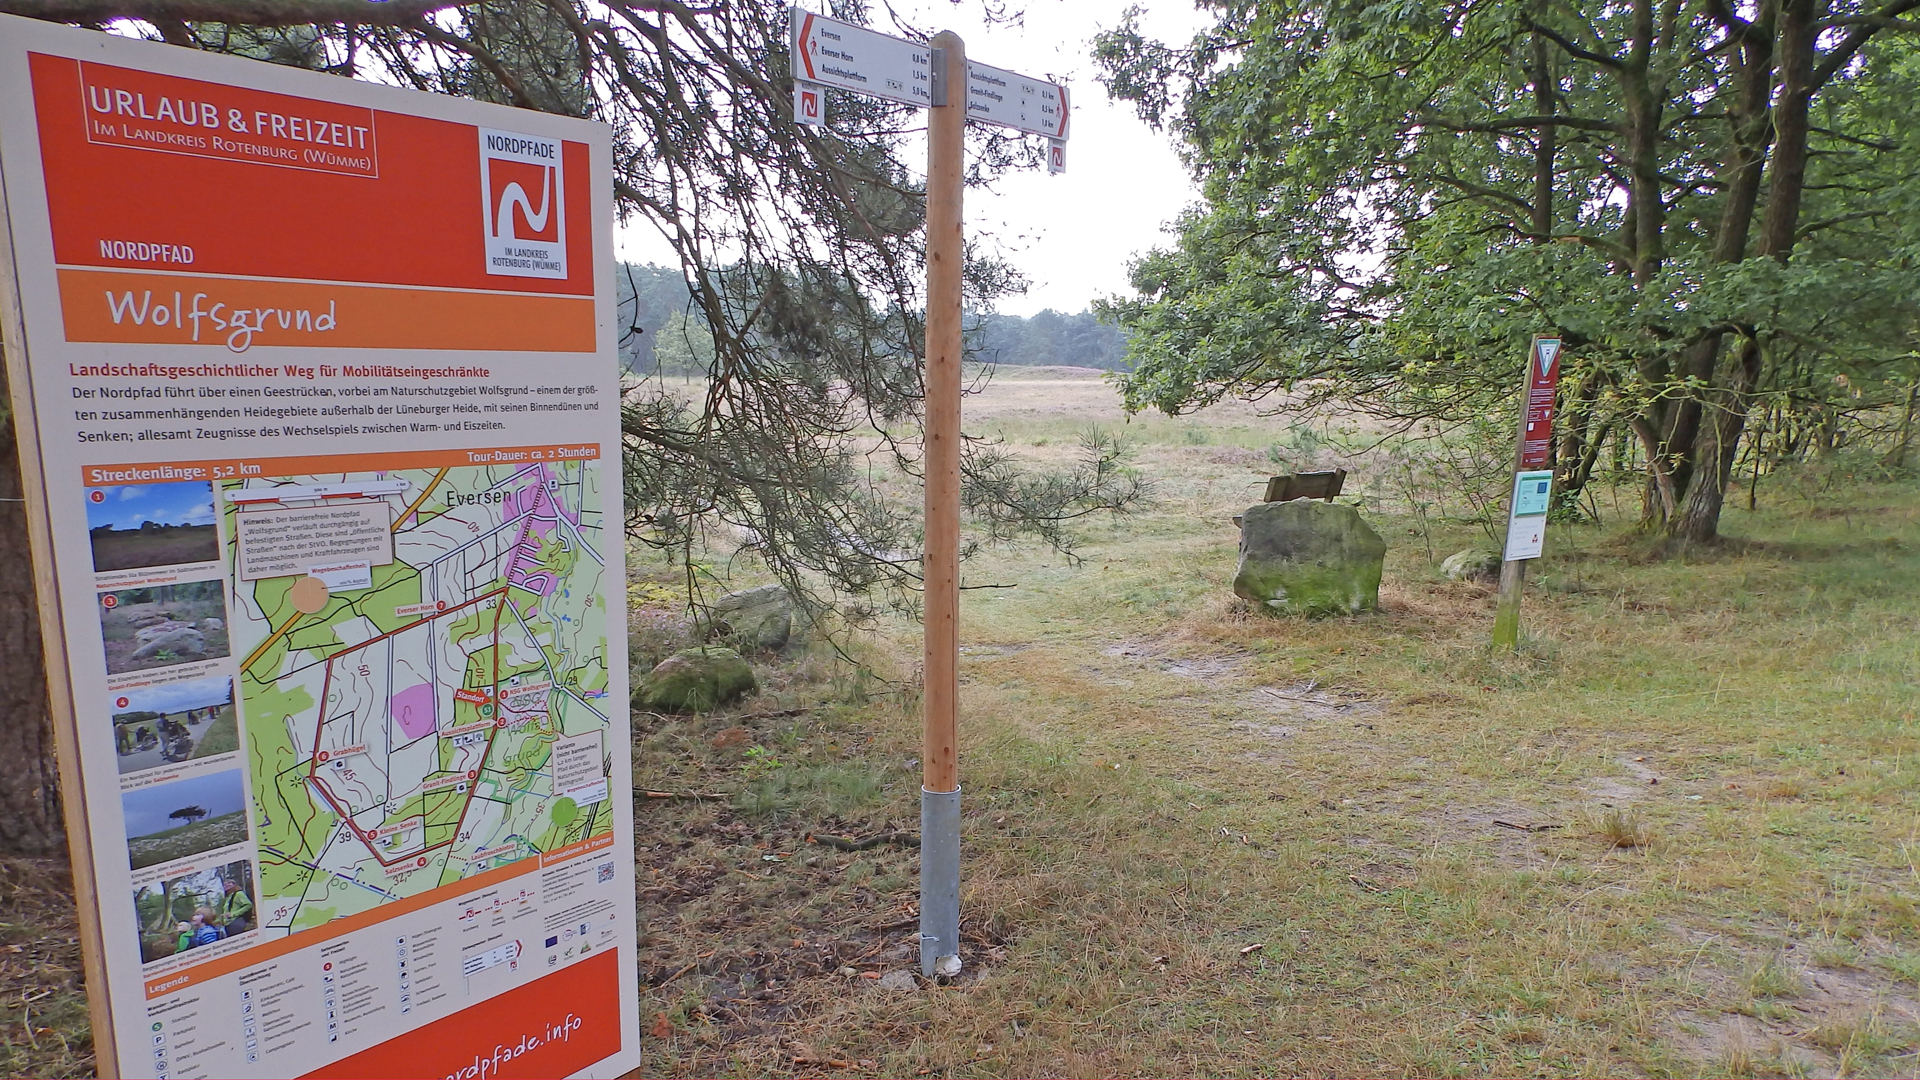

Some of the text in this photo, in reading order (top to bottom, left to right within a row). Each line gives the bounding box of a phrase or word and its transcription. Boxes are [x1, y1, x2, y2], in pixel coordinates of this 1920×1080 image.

[821, 28, 841, 41] Eversen
[821, 46, 853, 62] Everser Horn
[920, 55, 927, 65] km
[822, 64, 867, 83] Aussichtsplattform
[920, 72, 927, 81] km
[971, 71, 1006, 87] Aussichtsplattform
[920, 88, 927, 97] km
[970, 86, 1003, 102] Granit-Findlinge
[90, 85, 369, 150] URLAUB & FREIZEIT
[487, 135, 555, 159] NORDPFADE
[99, 238, 194, 264] NORDPFAD
[505, 247, 548, 260] IM LANDKREIS
[493, 257, 561, 272] ROTENBURG (WÜMME)
[105, 290, 337, 353] Wolfsgrund
[69, 362, 490, 380] Landschaftsgeschichtlicher Weg für Mobilitätseingeschränkte
[72, 385, 598, 400] Der Nordpfad führt über einen Geestrücken, vorbei am Naturschutzgebiet Wolfsgrund einem der größ-
[75, 402, 598, 421] ten zusammenhängenden Heidegebiete außerhalb der Lüneburger Heide, mit seinen Binnendünen und
[78, 421, 506, 442] Senken; allesamt Zeugnisse des Wechselspiels zwischen Warm- und Eiszeiten.
[467, 451, 528, 462] Tour-Dauer:
[558, 447, 597, 458] Stunden
[91, 463, 261, 482] Streckenlänge: 5,2 km
[446, 489, 512, 508] Eversen
[243, 518, 273, 526] Hinweis:
[289, 513, 329, 522] barrierefreie
[331, 510, 360, 519] Nordpfad
[292, 523, 318, 531] verläuft
[319, 520, 359, 529] durchgängig
[245, 536, 284, 545] befestigten
[286, 533, 314, 541] Straßen.
[329, 537, 372, 548] Begegnungen
[246, 553, 299, 564] Landmaschinen
[314, 547, 365, 559] Kraftfahrzeugen
[366, 544, 380, 552] sind
[269, 563, 298, 573] möglich.
[397, 607, 420, 615] Everser
[420, 604, 434, 613] Horn
[486, 599, 497, 610] 33
[358, 664, 370, 677] 50
[509, 687, 520, 695] NSG
[521, 681, 550, 694] Wolfsgrund
[568, 676, 577, 685] 29
[457, 691, 484, 702] Standort
[333, 745, 366, 757] Grabhügel
[556, 742, 576, 750] Variante
[342, 769, 356, 781] 45
[422, 774, 467, 790] Granit-Findlinge
[379, 825, 397, 836] Kleine
[399, 820, 418, 830] Senke
[339, 831, 352, 843] 39
[459, 831, 471, 843] 34
[471, 842, 515, 861] Laubfroschbiotop
[543, 844, 584, 863] Informationen
[591, 836, 612, 848] Partner
[385, 863, 413, 875] Salzsenke
[273, 905, 287, 922] 35
[149, 975, 190, 994] Legende
[438, 1013, 582, 1080] ordpfade.info
